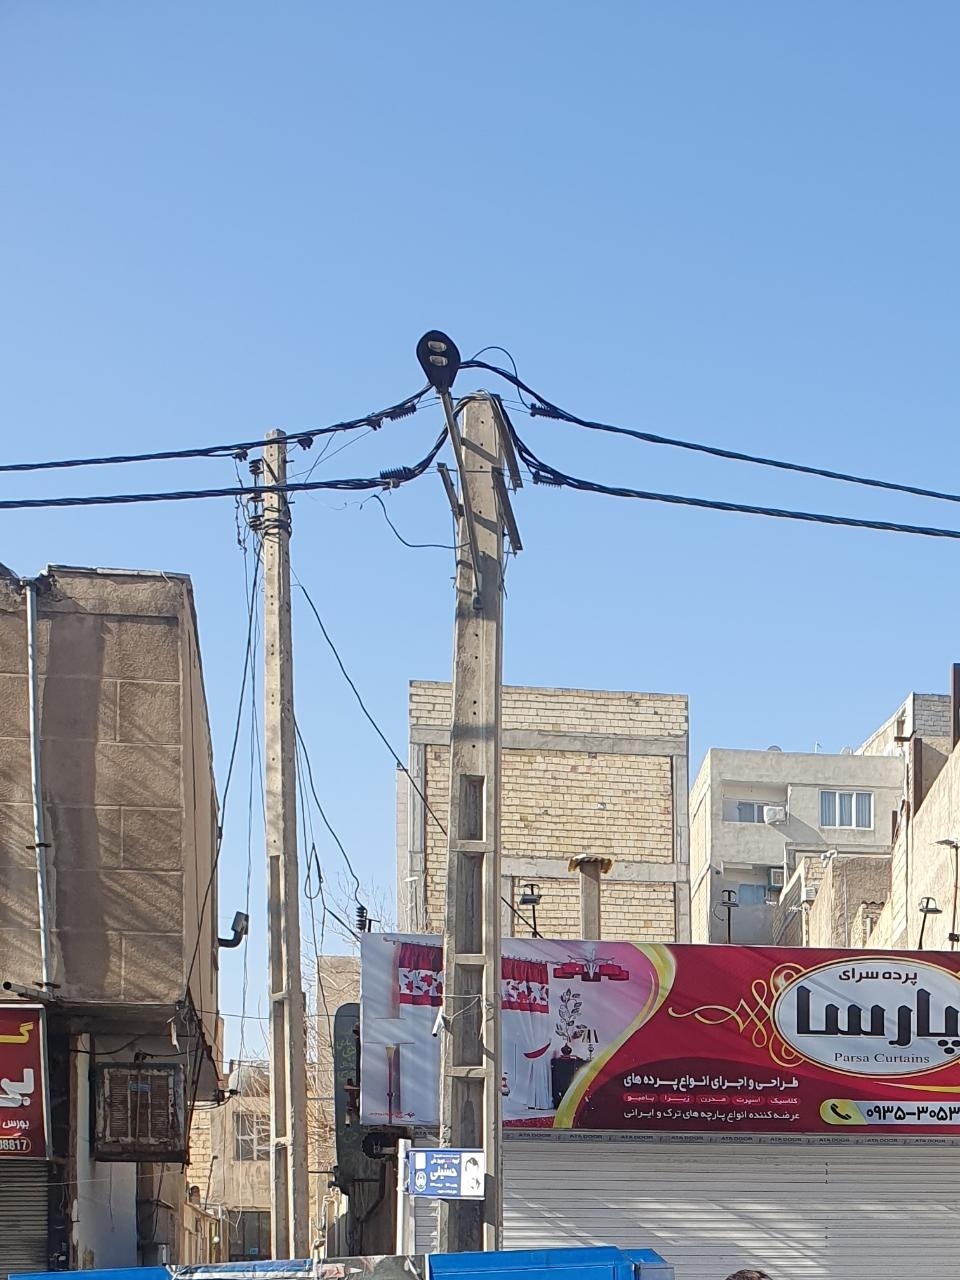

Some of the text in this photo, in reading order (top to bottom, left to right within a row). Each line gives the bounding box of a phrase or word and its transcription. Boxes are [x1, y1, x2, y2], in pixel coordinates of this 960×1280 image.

[838, 967, 918, 986] پرده سرای
[834, 1052, 930, 1064] Parsa Curtains
[623, 1072, 799, 1091] طراحی و اجرای انواع پرده های
[623, 1108, 655, 1119] ایرانی
[663, 1108, 681, 1119] ترک
[683, 1109, 699, 1119] های
[700, 1111, 726, 1122] پارچه
[726, 1110, 747, 1123] انواع
[2, 1119, 30, 1130] بورس
